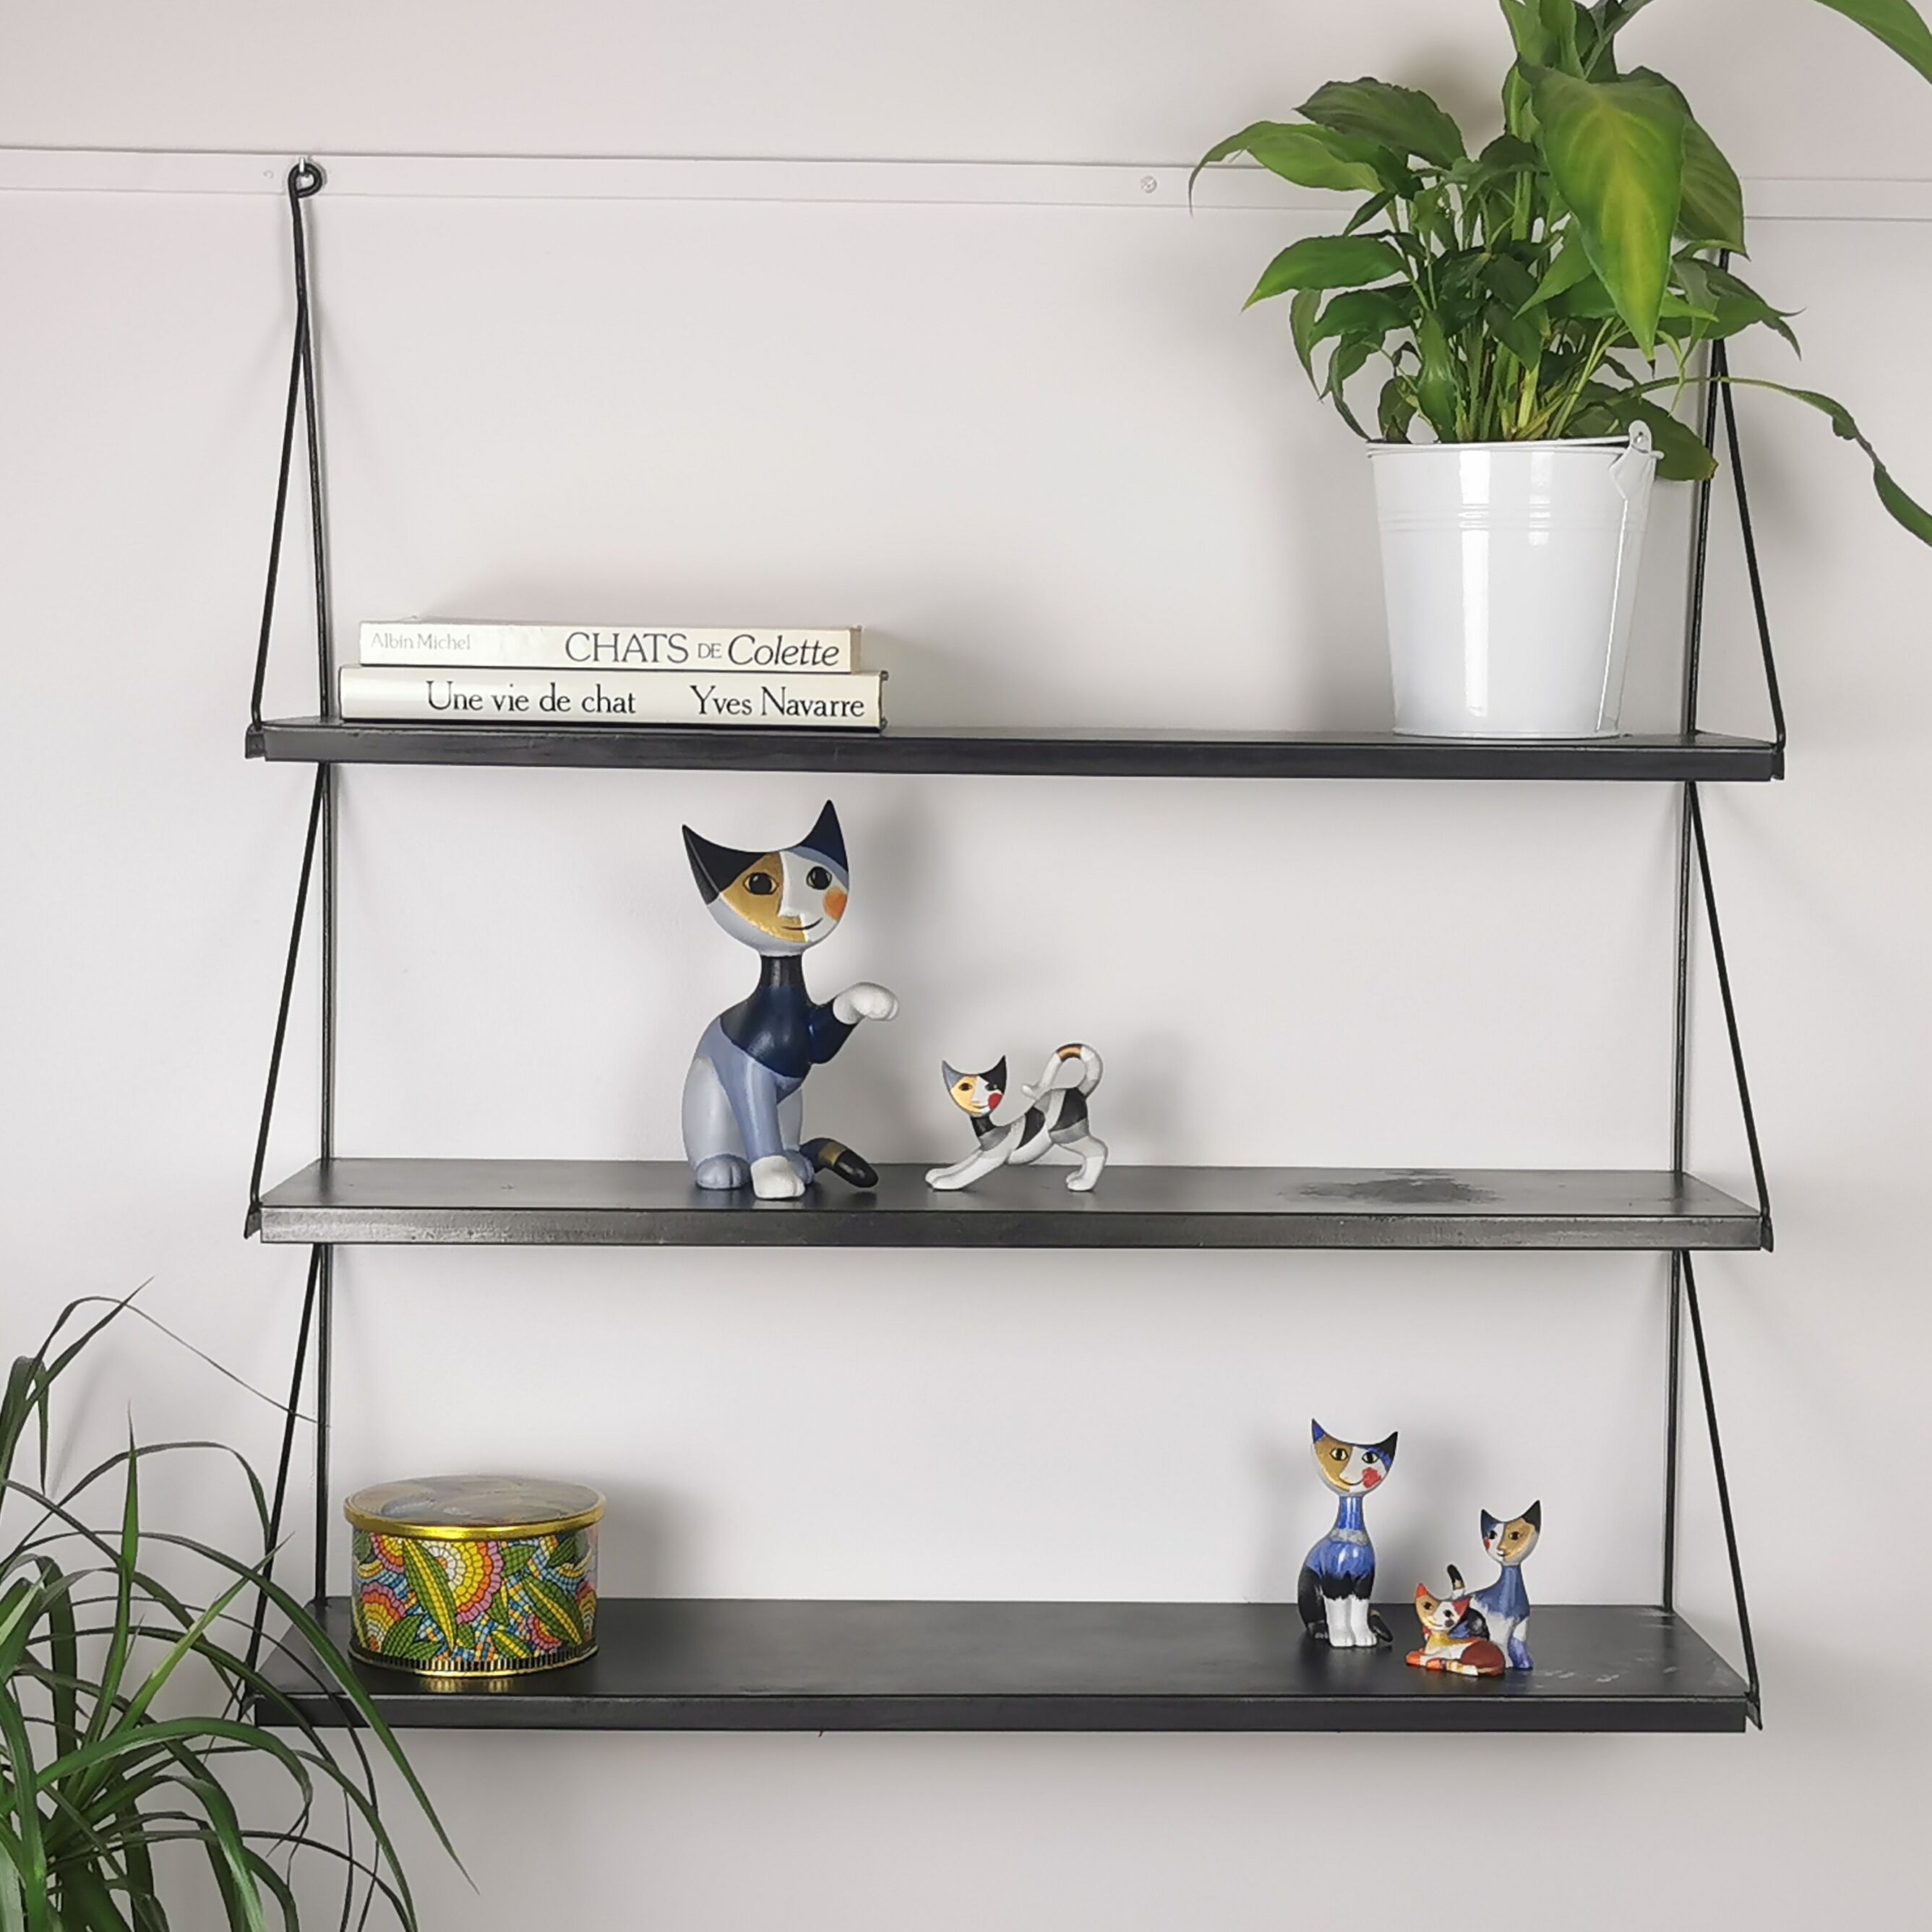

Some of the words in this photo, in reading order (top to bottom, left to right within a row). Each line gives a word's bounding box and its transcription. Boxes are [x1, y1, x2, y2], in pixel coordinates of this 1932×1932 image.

[370, 632, 413, 650] Albin
[416, 632, 471, 651] Michel
[565, 632, 690, 664] CHATS
[697, 643, 721, 659] DE
[728, 634, 840, 666] Colette
[426, 680, 484, 710] Une
[491, 683, 529, 712] vie
[539, 682, 571, 713] de
[581, 683, 636, 714] chat
[690, 684, 752, 716] Yves
[760, 686, 865, 718] Navarre
